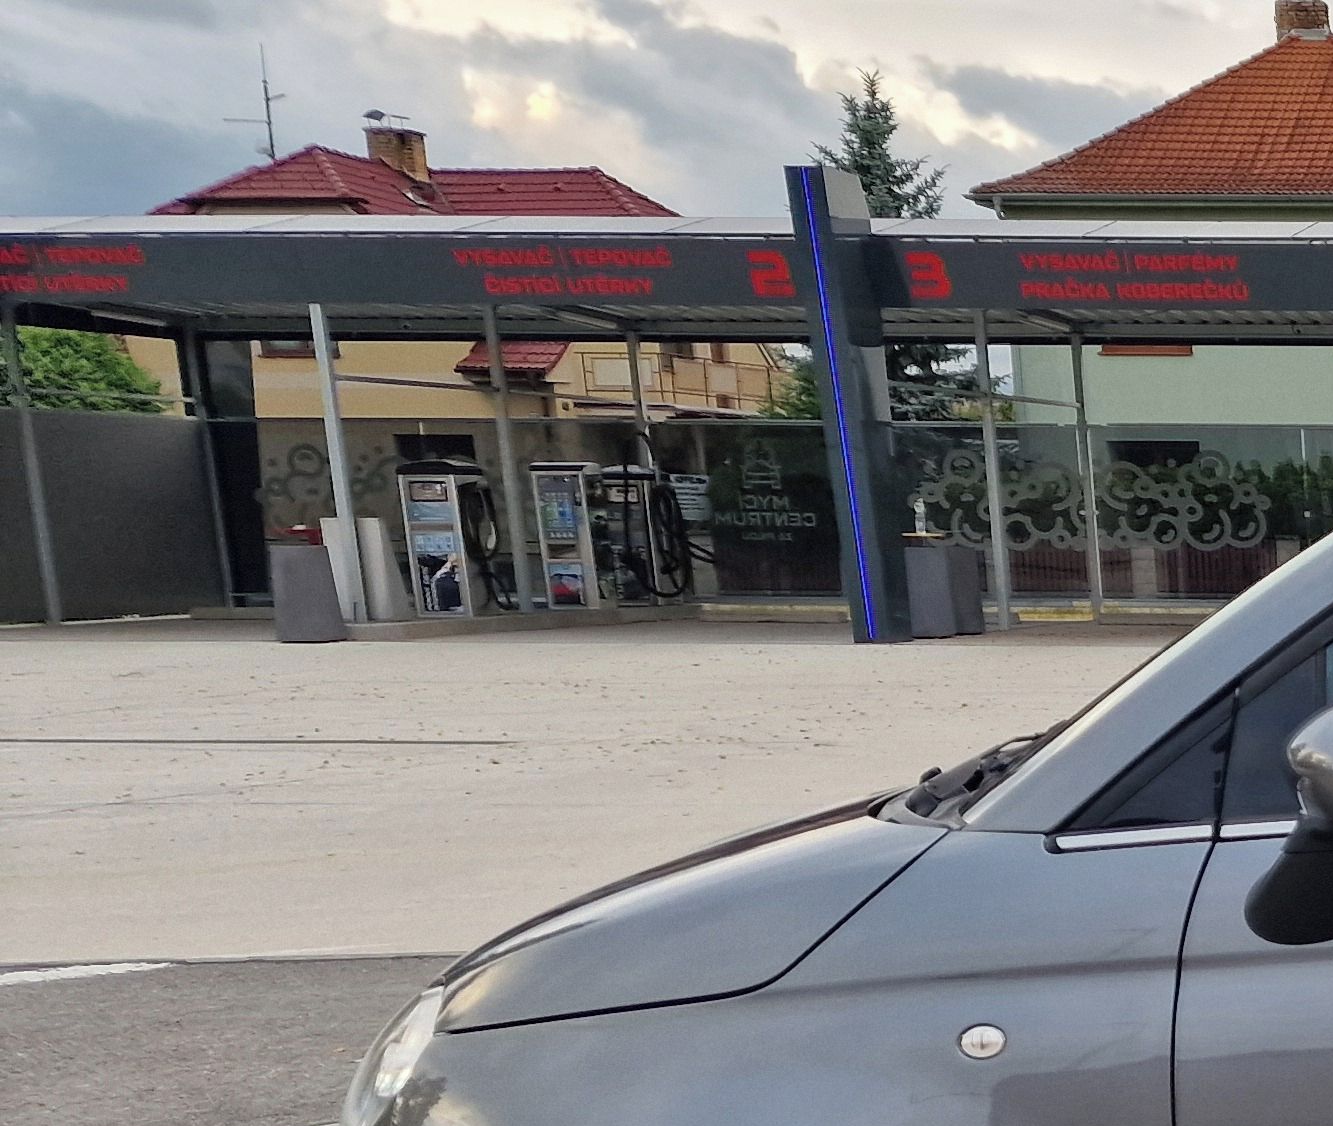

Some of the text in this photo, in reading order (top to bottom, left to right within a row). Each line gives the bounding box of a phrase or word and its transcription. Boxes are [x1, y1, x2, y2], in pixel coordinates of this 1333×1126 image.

[453, 245, 672, 267] VYSAVAČ TEPOVAČ
[1019, 250, 1120, 272] VYSAVAČ
[747, 250, 795, 298] 2
[905, 251, 952, 298] 3
[1019, 277, 1111, 300] PRAČKA
